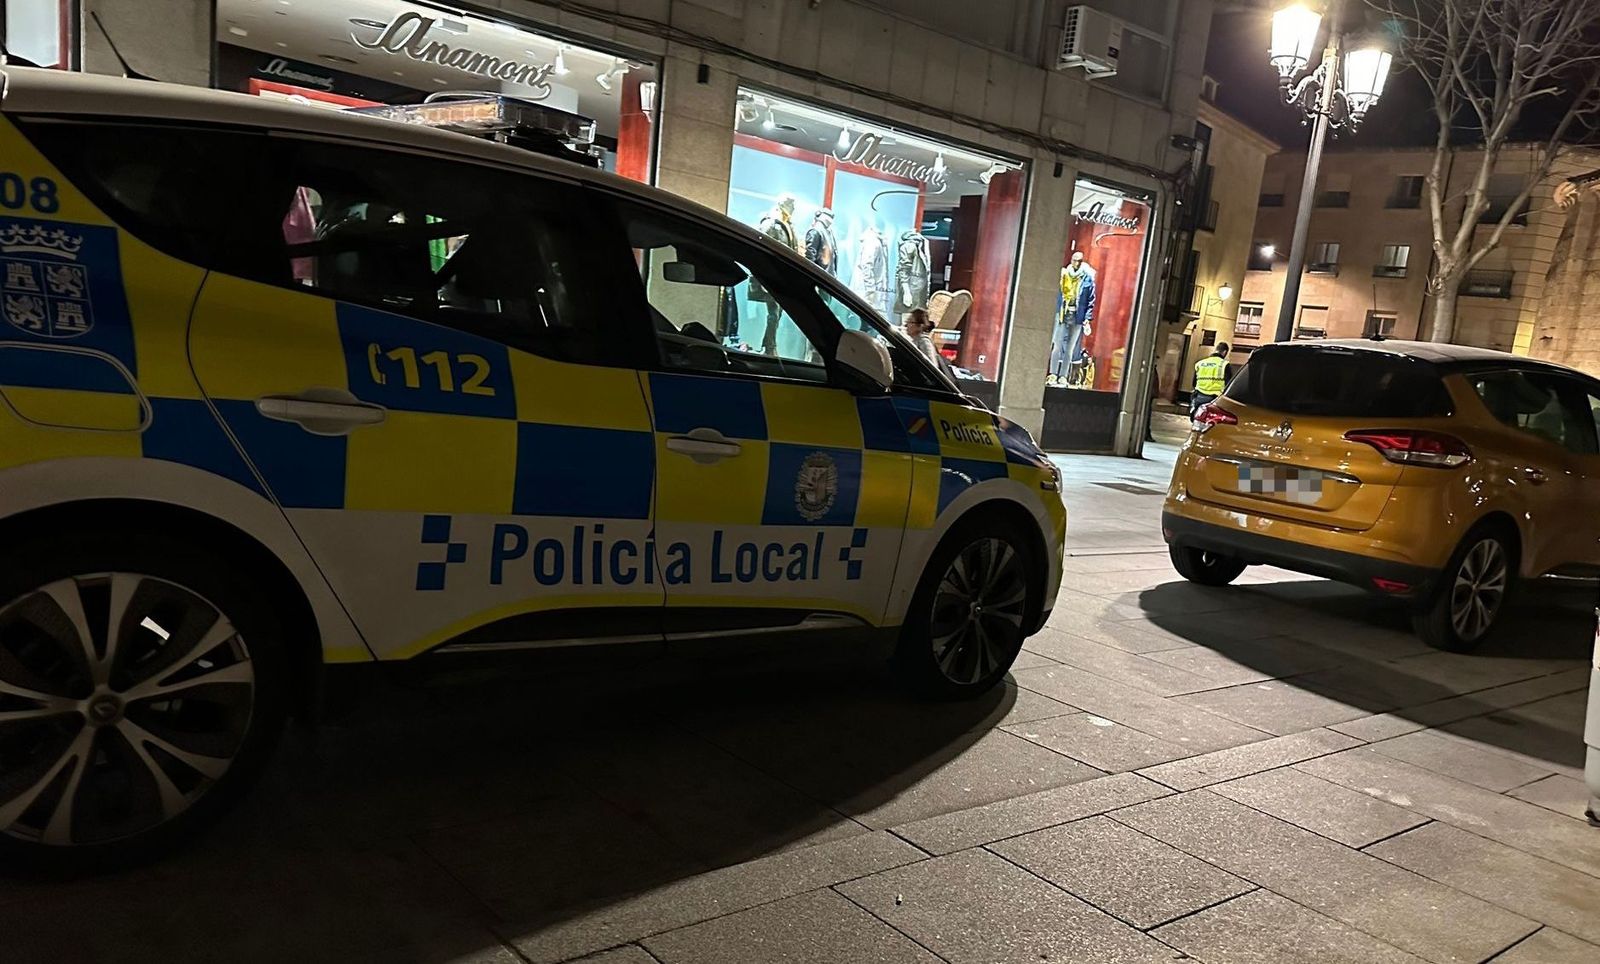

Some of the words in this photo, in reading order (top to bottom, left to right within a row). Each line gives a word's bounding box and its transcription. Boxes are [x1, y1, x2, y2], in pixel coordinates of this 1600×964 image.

[351, 12, 556, 102] Anamont
[0, 172, 59, 214] 08
[386, 347, 496, 397] 112
[941, 419, 993, 446] Policía
[490, 524, 692, 585] Policía
[711, 530, 825, 583] Local
